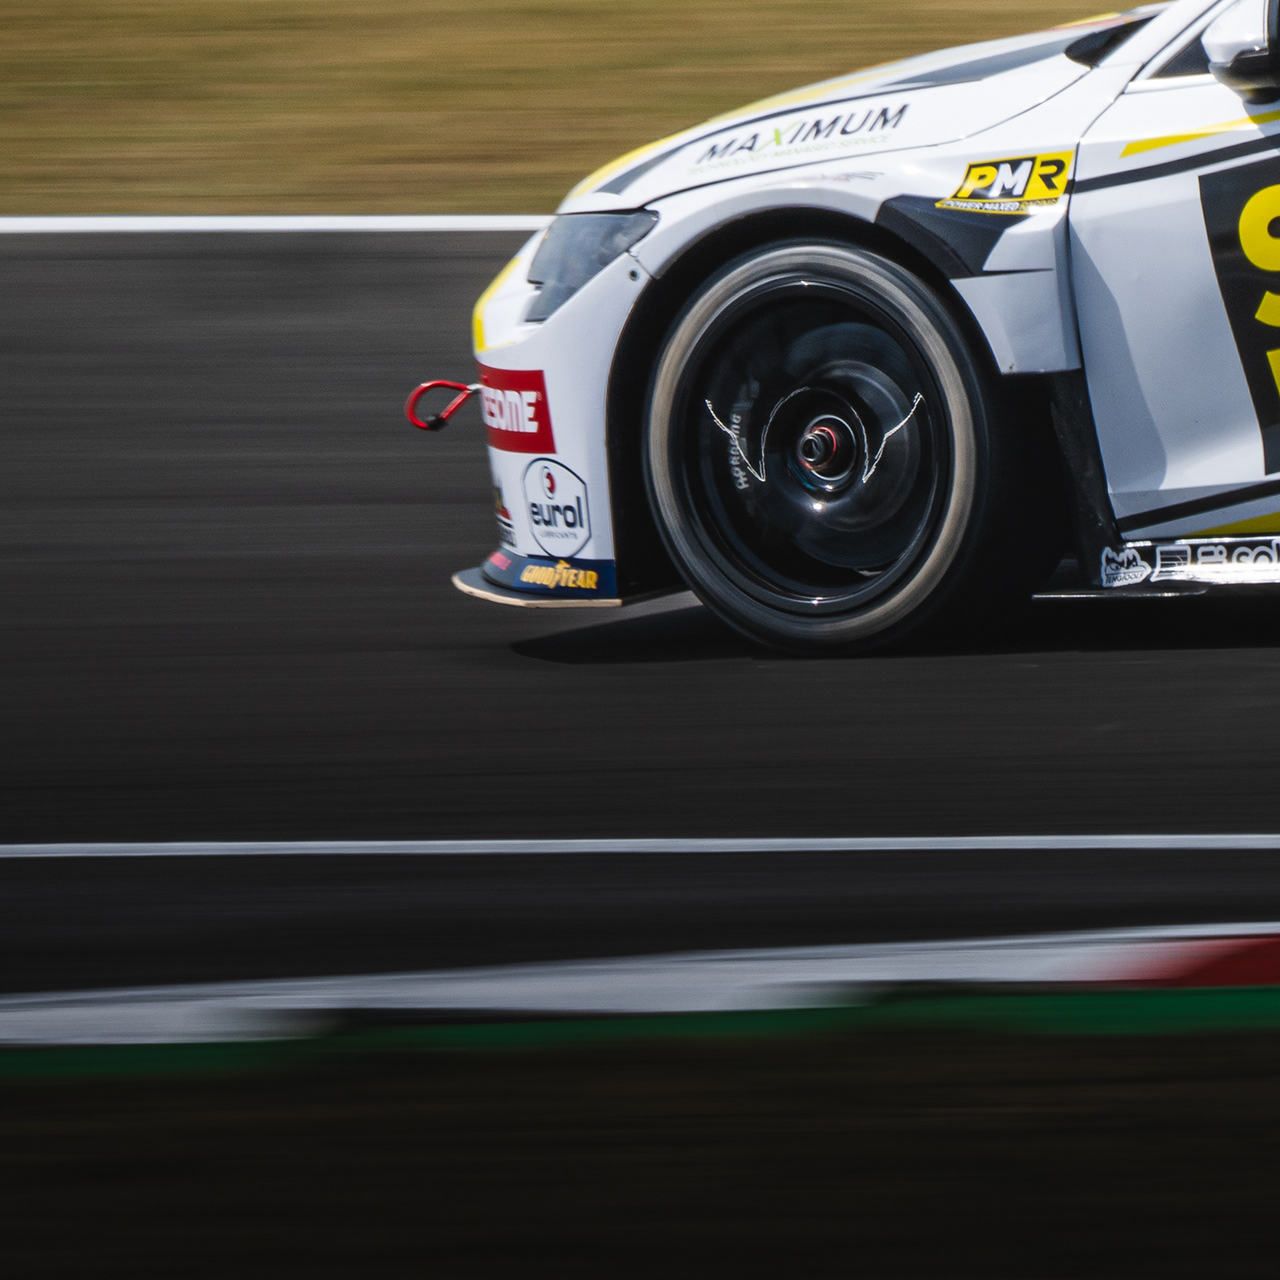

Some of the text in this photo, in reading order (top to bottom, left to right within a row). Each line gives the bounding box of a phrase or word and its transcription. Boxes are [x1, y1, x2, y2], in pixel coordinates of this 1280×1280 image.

[697, 104, 911, 164] MAXIMUM
[957, 158, 1067, 199] PMR
[531, 496, 585, 529] eurol
[519, 559, 599, 589] GOODYEAR
